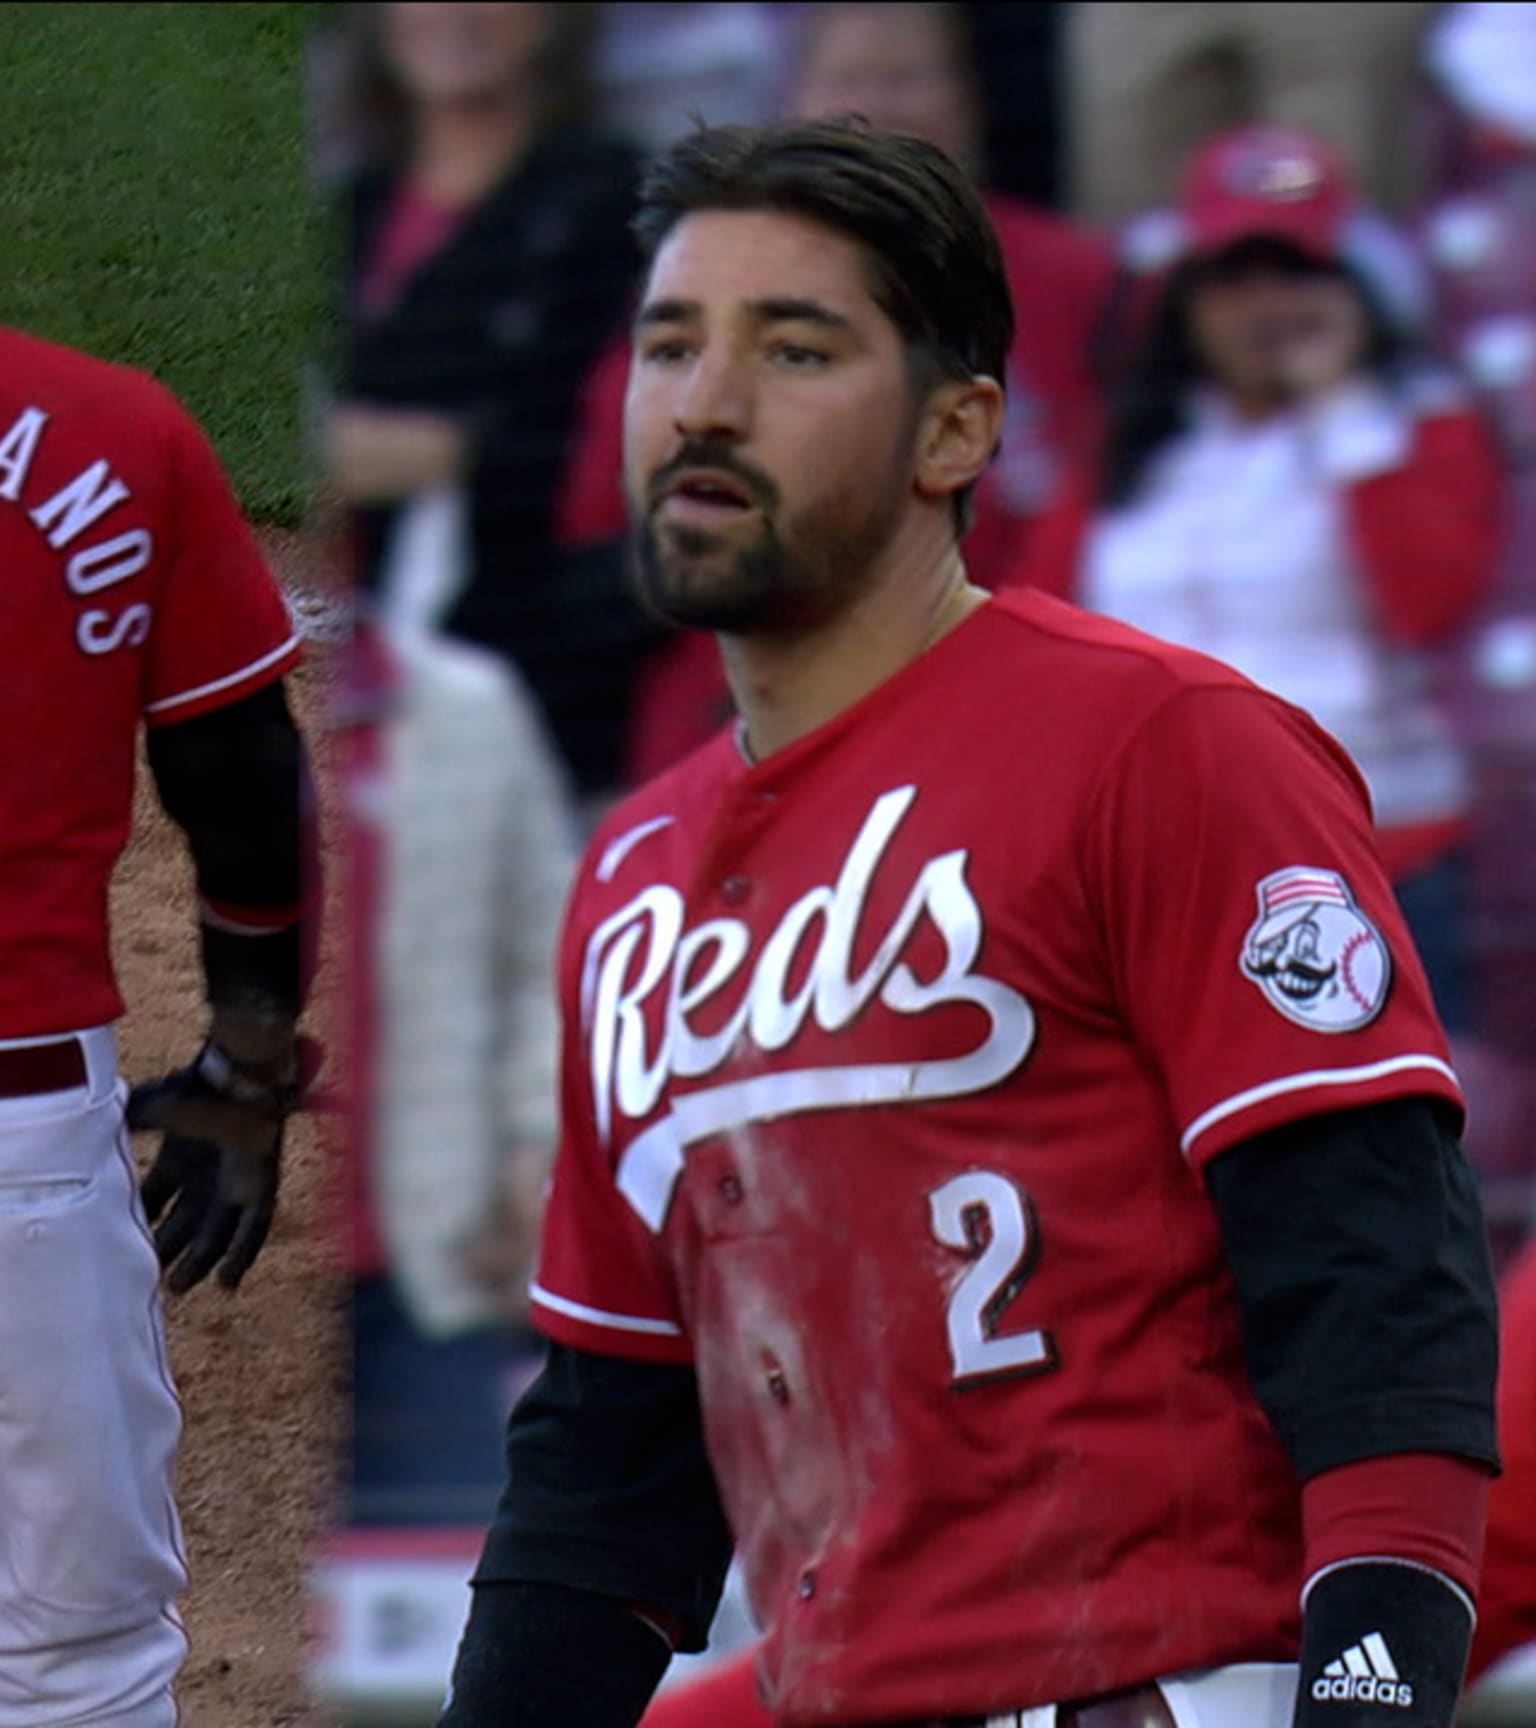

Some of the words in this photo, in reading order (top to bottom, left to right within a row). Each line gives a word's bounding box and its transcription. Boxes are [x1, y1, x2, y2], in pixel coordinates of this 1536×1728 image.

[580, 784, 1036, 1233] Reds
[928, 1171, 1054, 1388] 2
[1312, 1674, 1413, 1707] adidas
